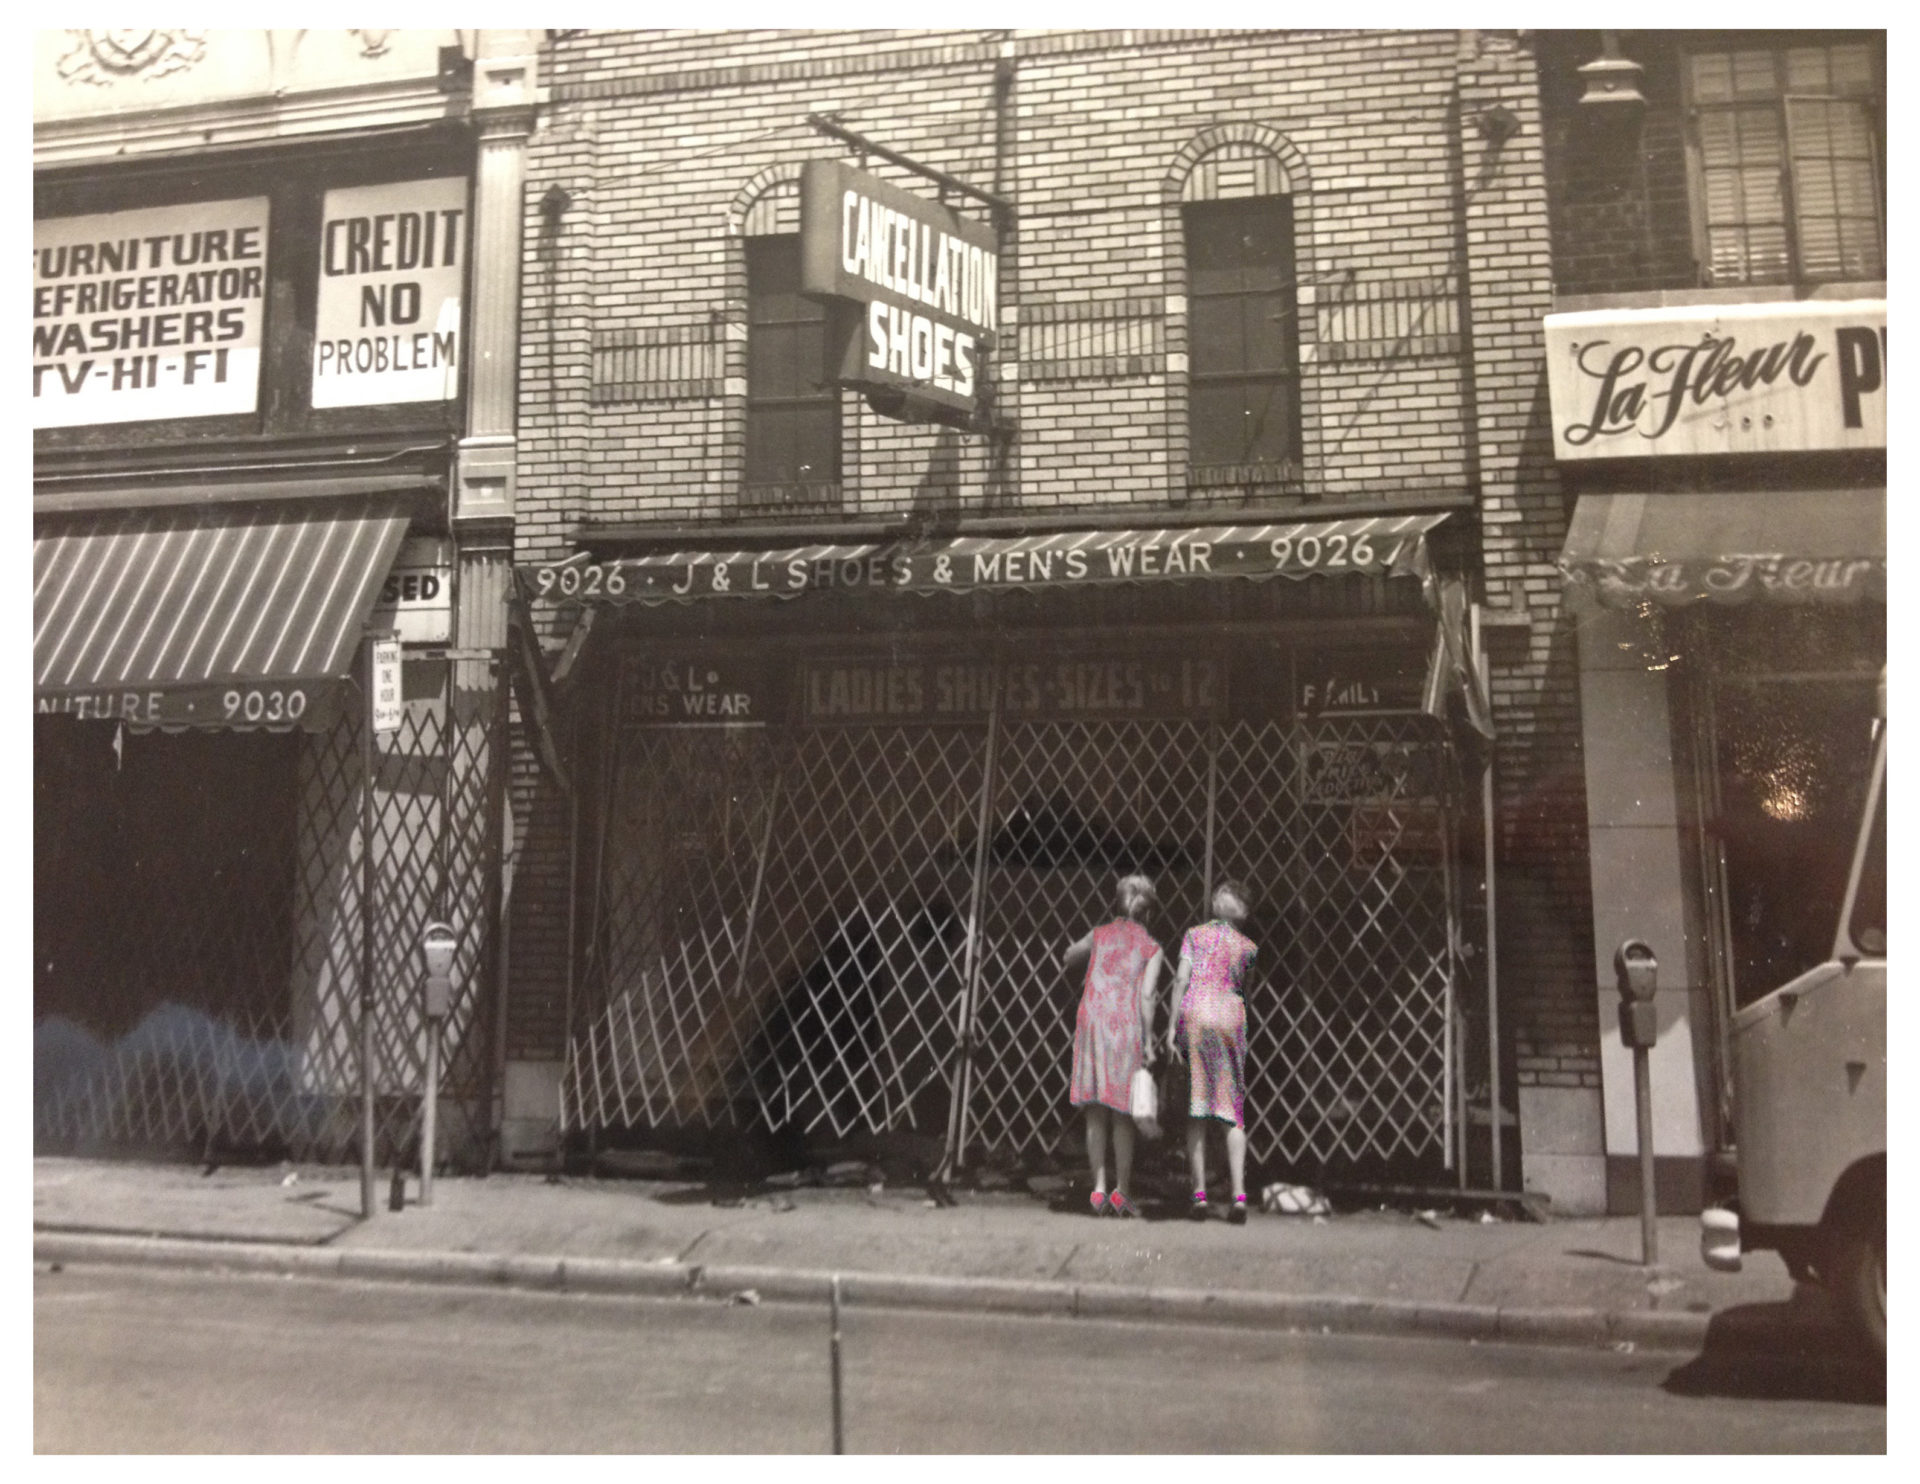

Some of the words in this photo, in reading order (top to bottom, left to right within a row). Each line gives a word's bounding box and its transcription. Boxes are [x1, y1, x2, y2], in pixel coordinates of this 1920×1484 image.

[324, 209, 463, 277] CREDIT
[842, 189, 996, 332] CANCELLATION
[360, 282, 421, 327] NO
[318, 331, 456, 376] PROBLEM
[869, 300, 974, 397] SHOES
[1564, 340, 1647, 446] La
[1638, 329, 1829, 439] Fleur
[1835, 326, 1887, 429] P
[537, 565, 626, 595] 9026
[672, 564, 693, 594] J
[712, 562, 731, 591] &
[787, 557, 912, 589] SHOES
[933, 554, 952, 583] &
[974, 550, 1088, 583] MEN'S
[1107, 543, 1213, 577] WEAR
[1270, 534, 1375, 570] 9026
[223, 690, 306, 721] 9030
[682, 693, 752, 716] WEAR
[809, 668, 922, 715] LADIES
